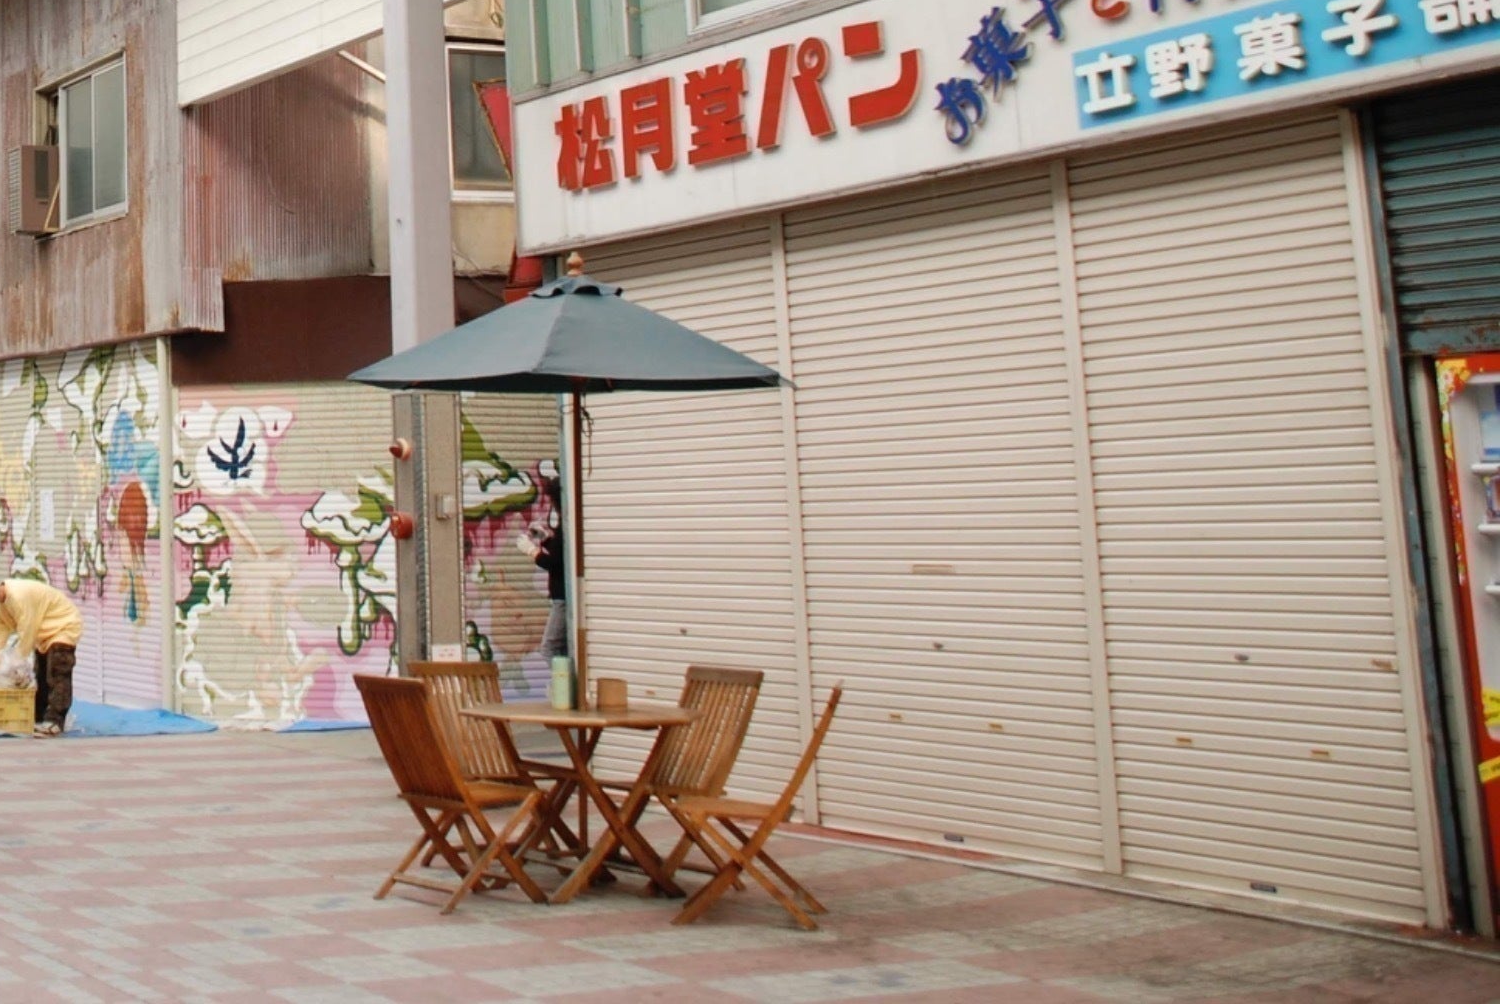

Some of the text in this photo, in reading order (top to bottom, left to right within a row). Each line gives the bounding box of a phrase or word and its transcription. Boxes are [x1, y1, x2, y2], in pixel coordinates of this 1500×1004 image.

[554, 20, 923, 193] 松月堂パン
